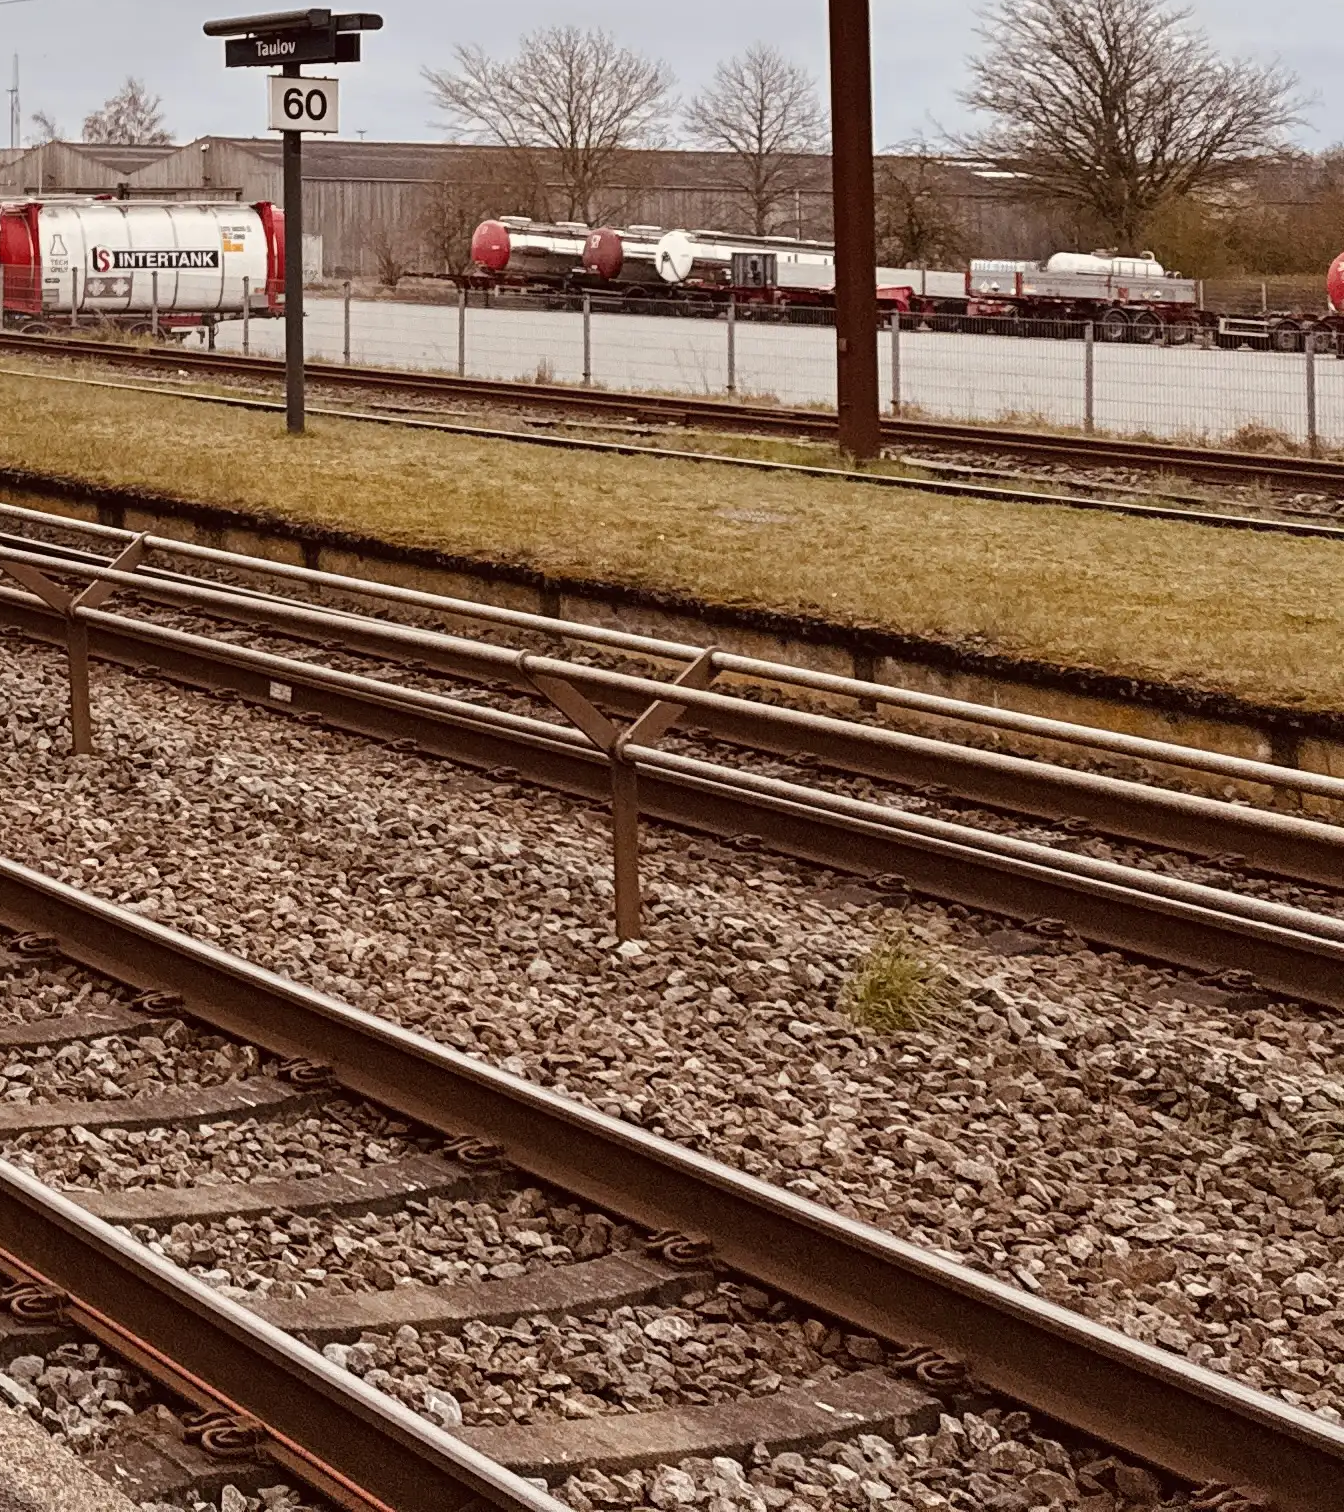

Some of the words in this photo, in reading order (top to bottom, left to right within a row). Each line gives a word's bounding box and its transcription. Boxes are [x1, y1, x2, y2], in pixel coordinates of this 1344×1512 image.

[256, 39, 296, 57] Taulov
[283, 87, 327, 121] 60
[118, 251, 215, 267] INTERTANK
